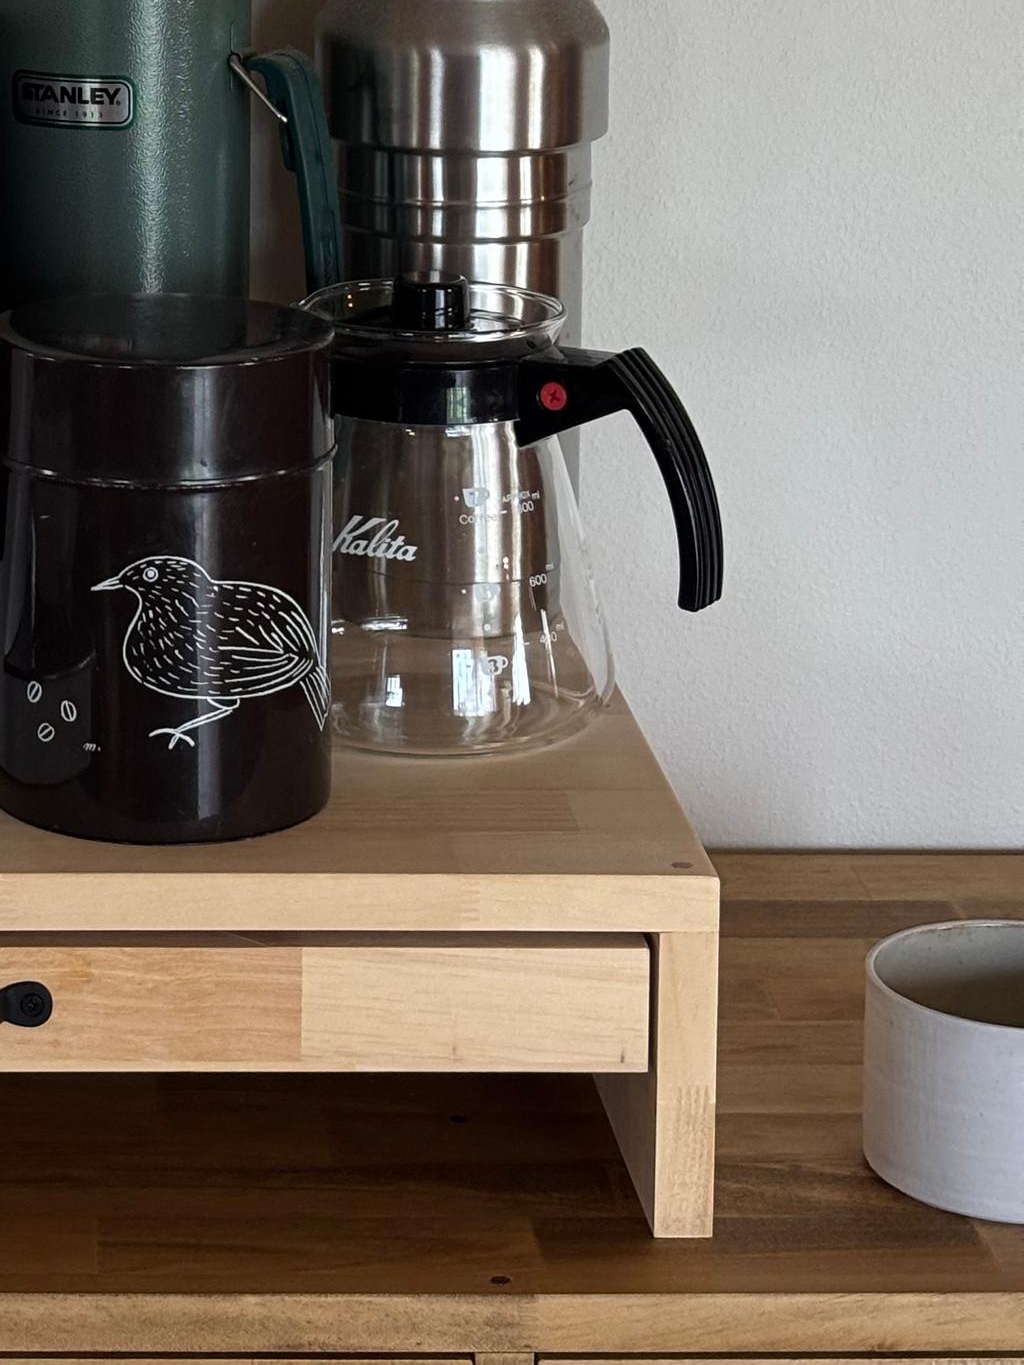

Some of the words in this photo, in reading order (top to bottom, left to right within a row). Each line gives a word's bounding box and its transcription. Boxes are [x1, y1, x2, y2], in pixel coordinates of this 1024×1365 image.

[21, 82, 121, 106] STANLEY
[35, 108, 68, 117] SINCE
[332, 515, 418, 561] Kalita
[529, 573, 547, 587] 600
